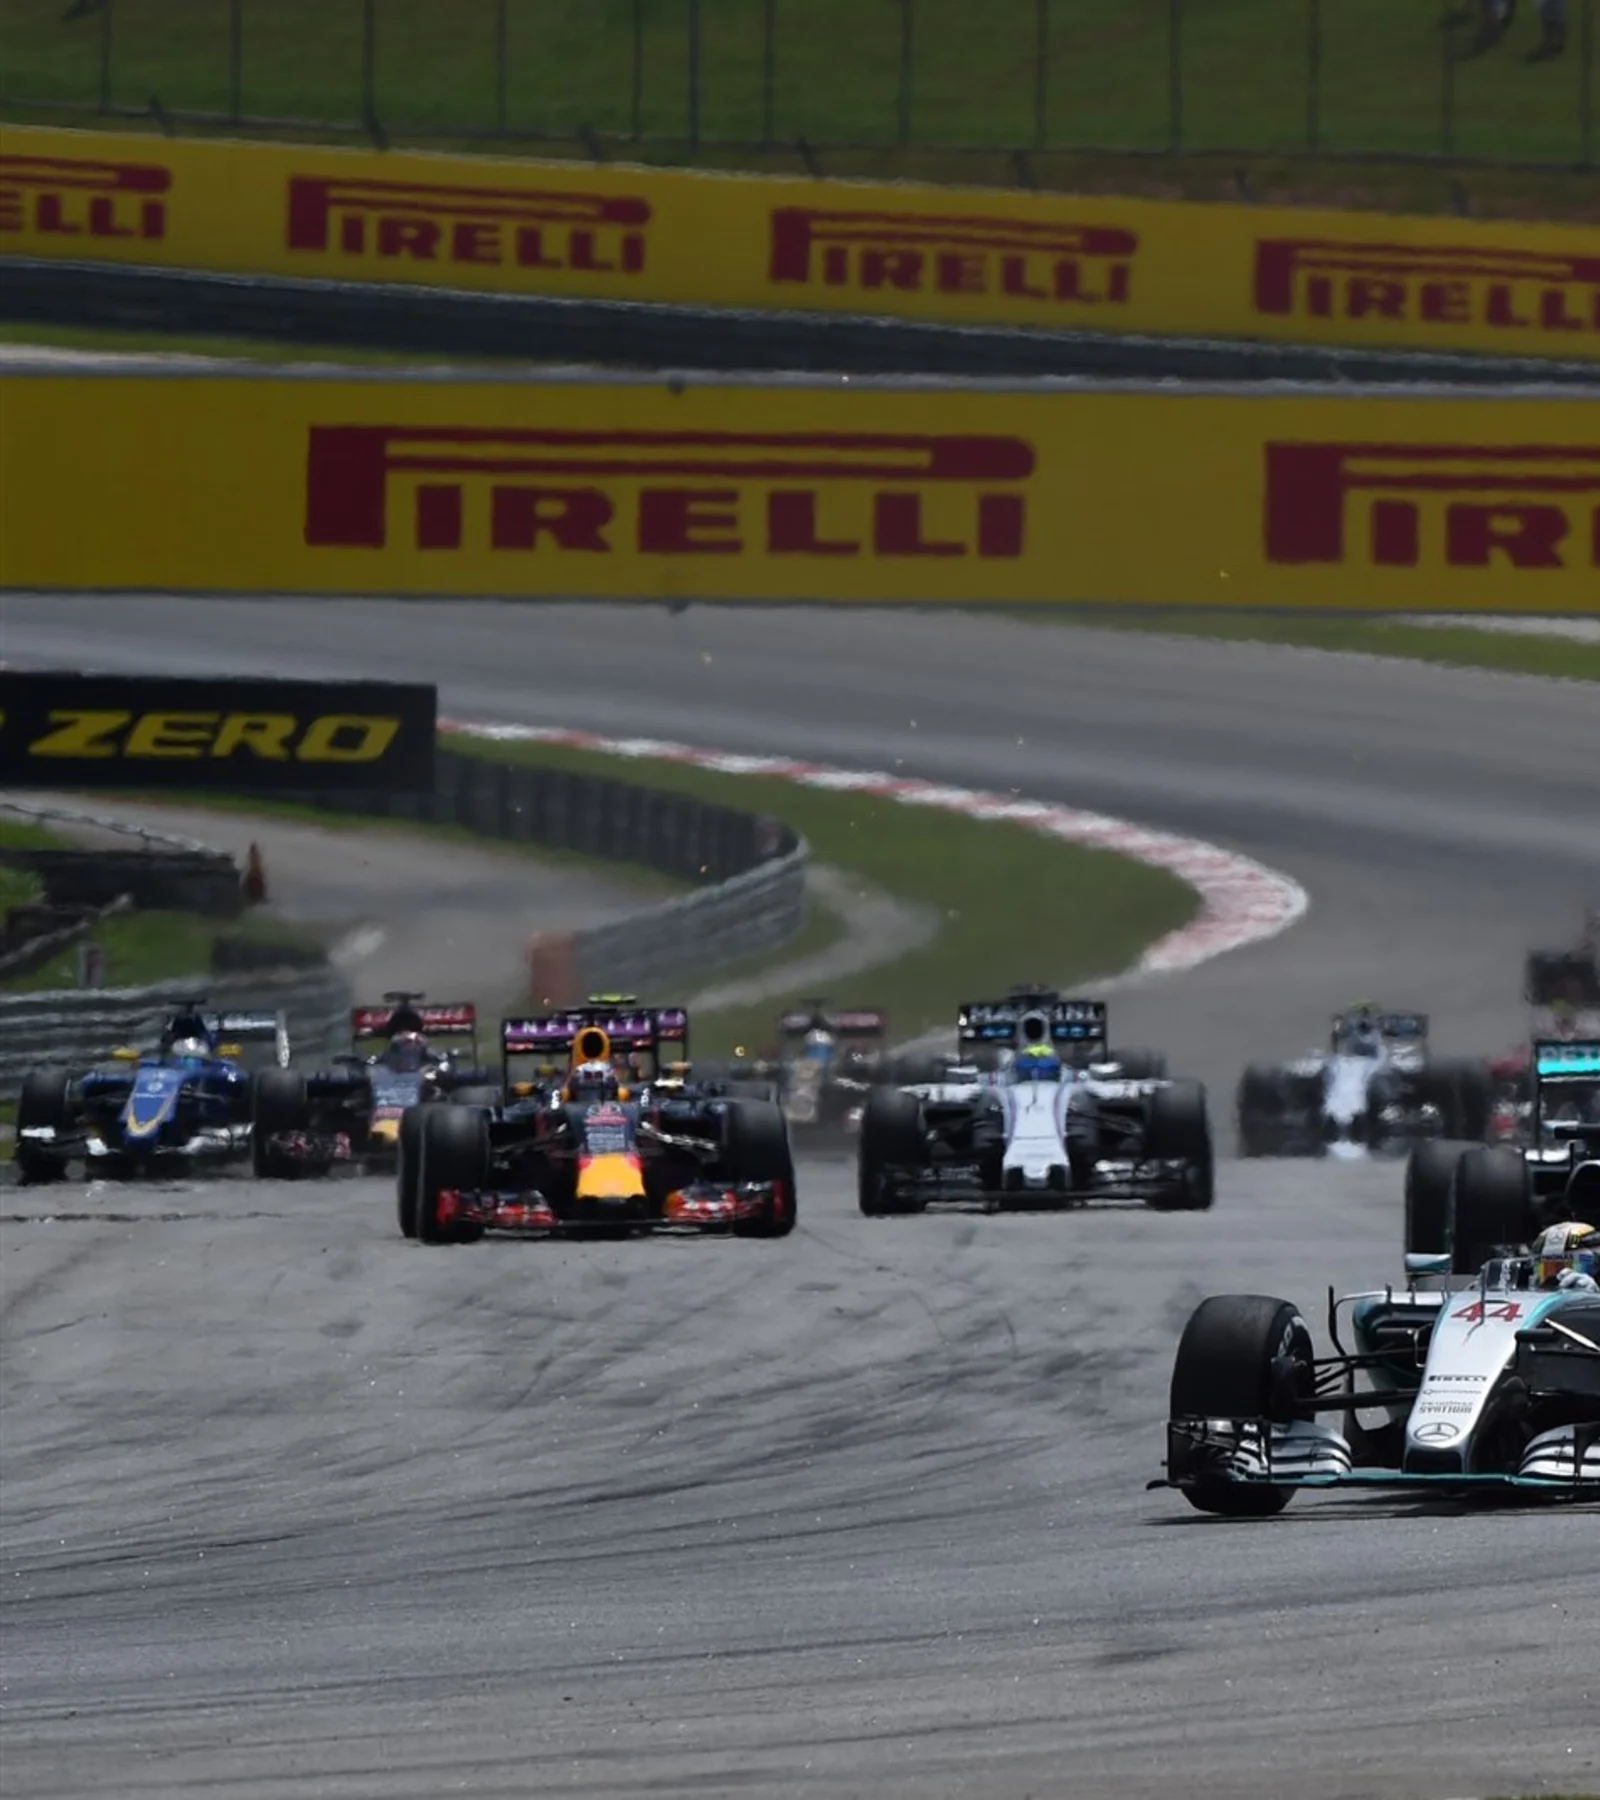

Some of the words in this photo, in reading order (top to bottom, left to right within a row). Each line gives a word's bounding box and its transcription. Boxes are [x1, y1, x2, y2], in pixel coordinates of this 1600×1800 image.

[287, 176, 652, 273] PIRELLI
[769, 208, 1138, 303] PIRELLI
[304, 424, 1037, 560] PIRELLI
[29, 710, 400, 763] ZERO
[1451, 1300, 1523, 1322] 44
